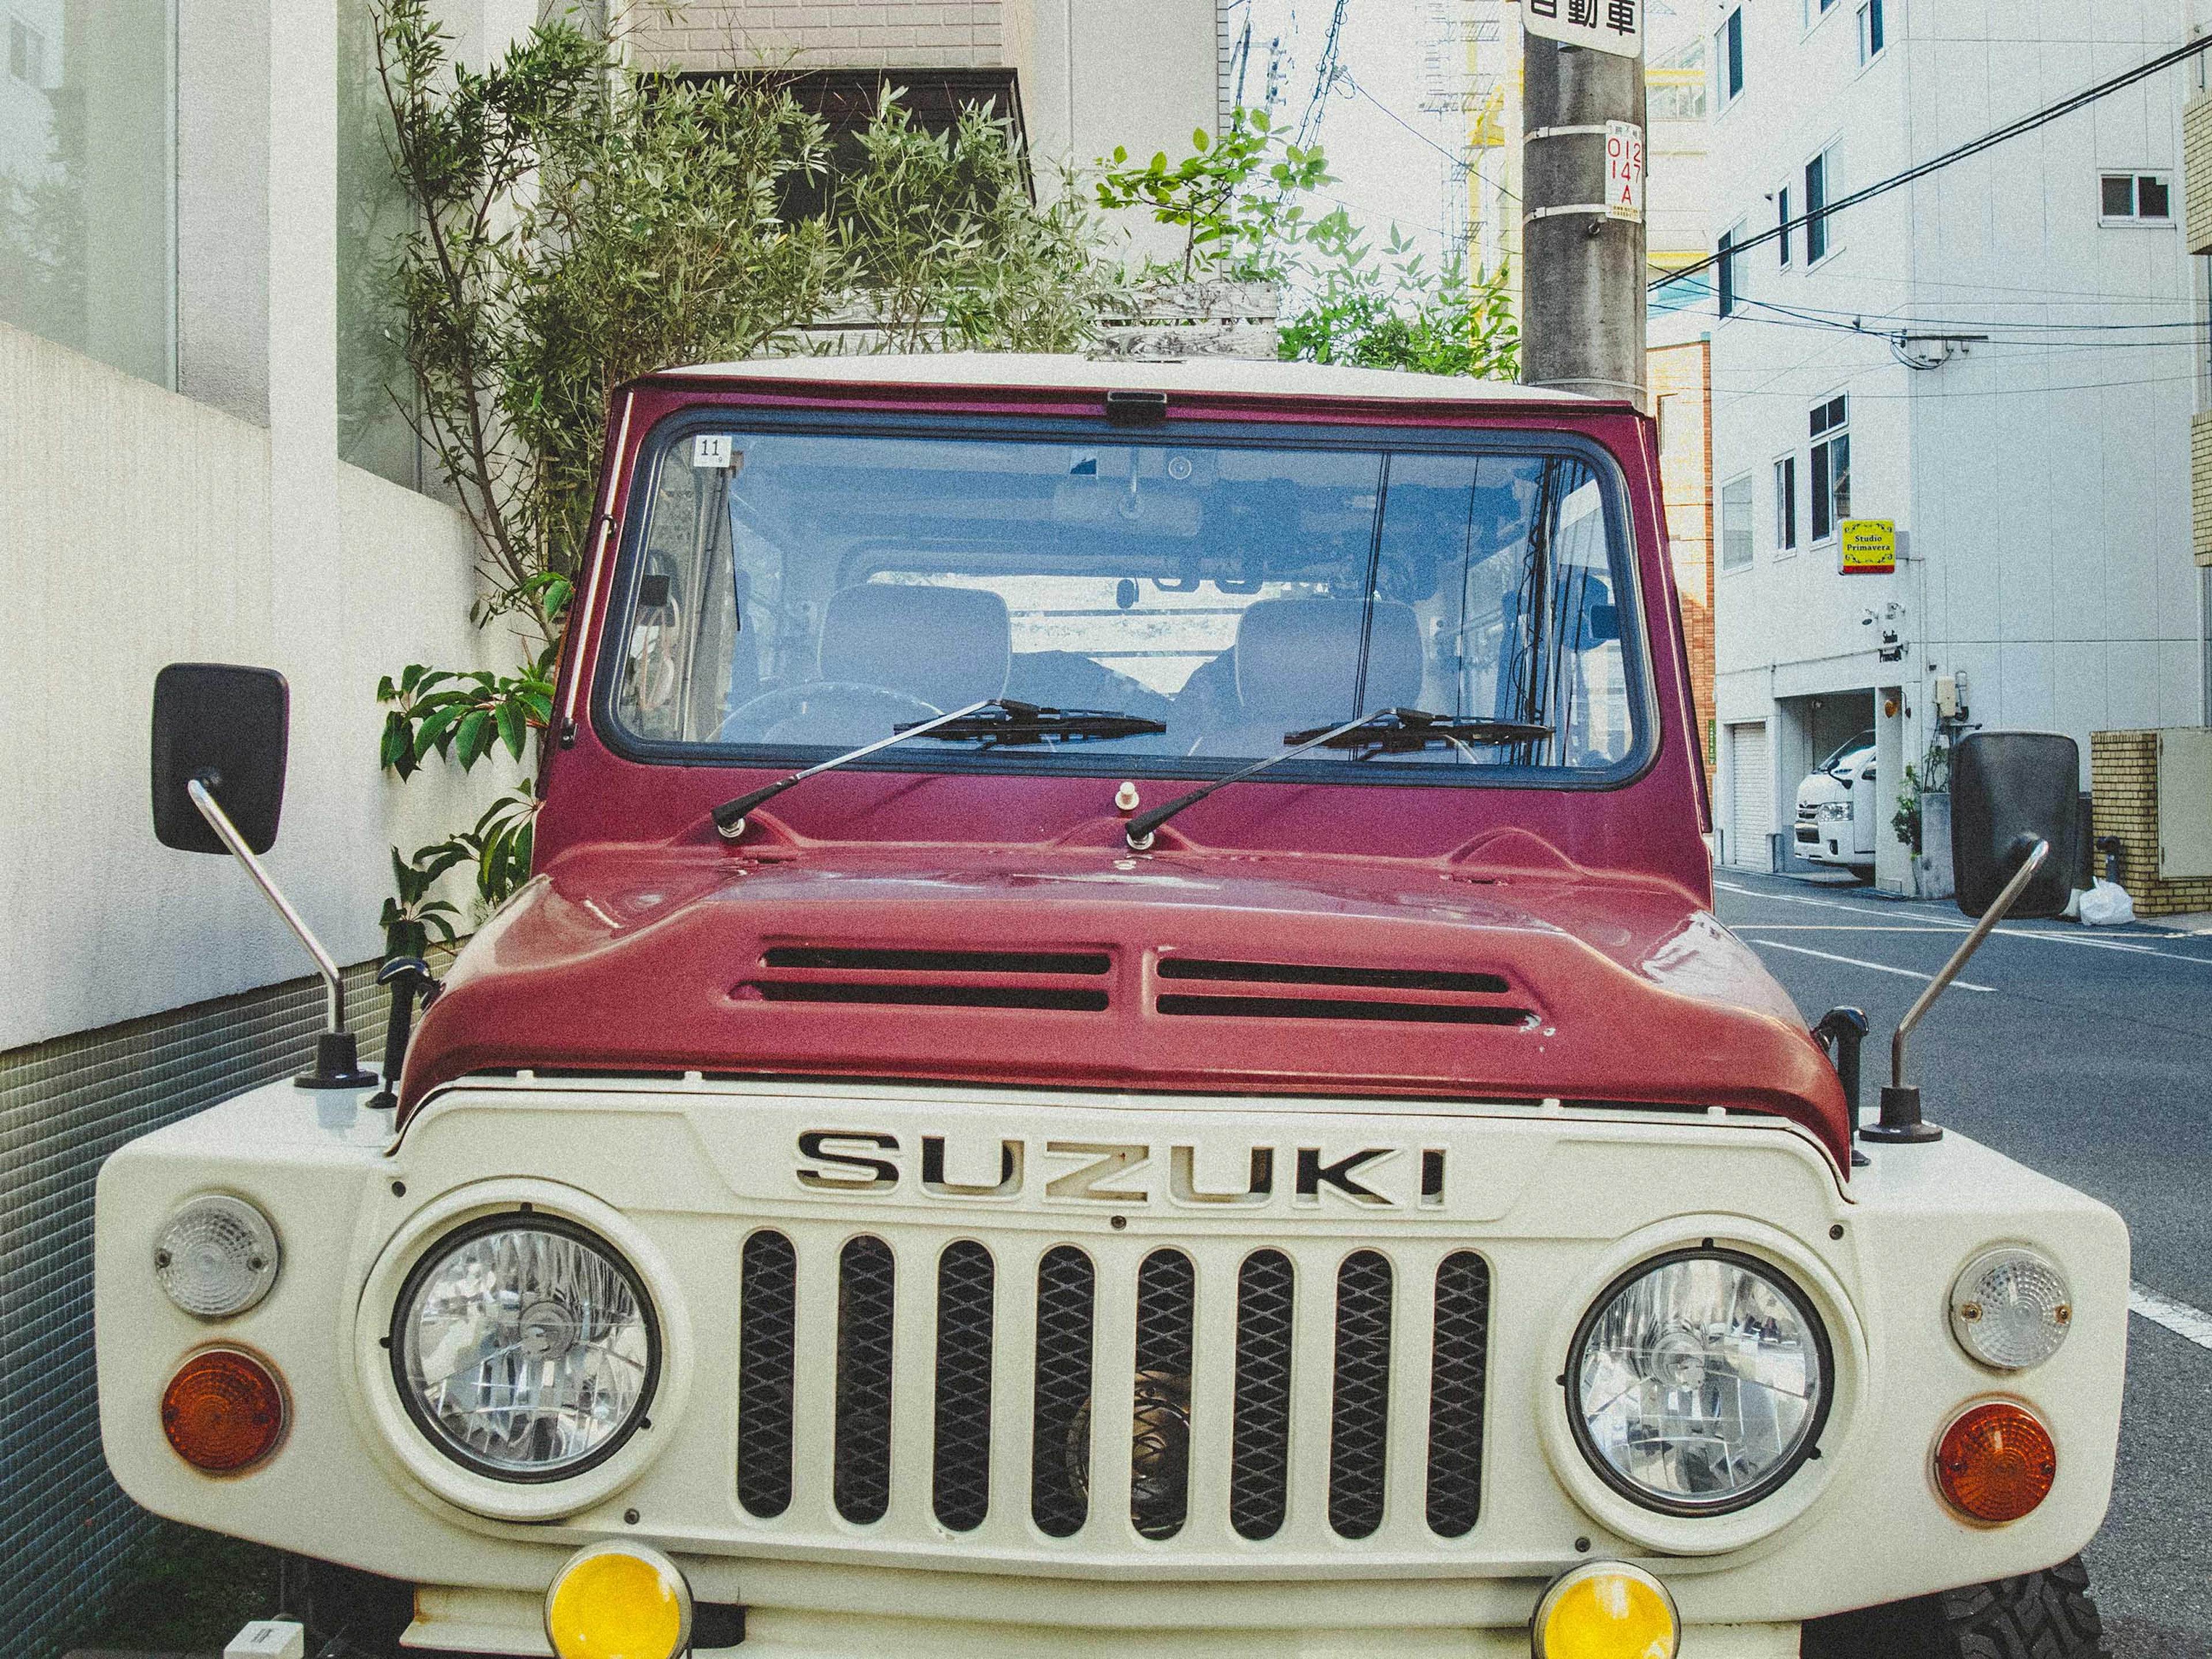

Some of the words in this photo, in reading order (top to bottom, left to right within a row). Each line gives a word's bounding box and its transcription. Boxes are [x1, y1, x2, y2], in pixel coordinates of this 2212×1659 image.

[1622, 185, 1632, 206] A
[701, 439, 719, 456] 11
[796, 1129, 1446, 1206] SUZUKI
